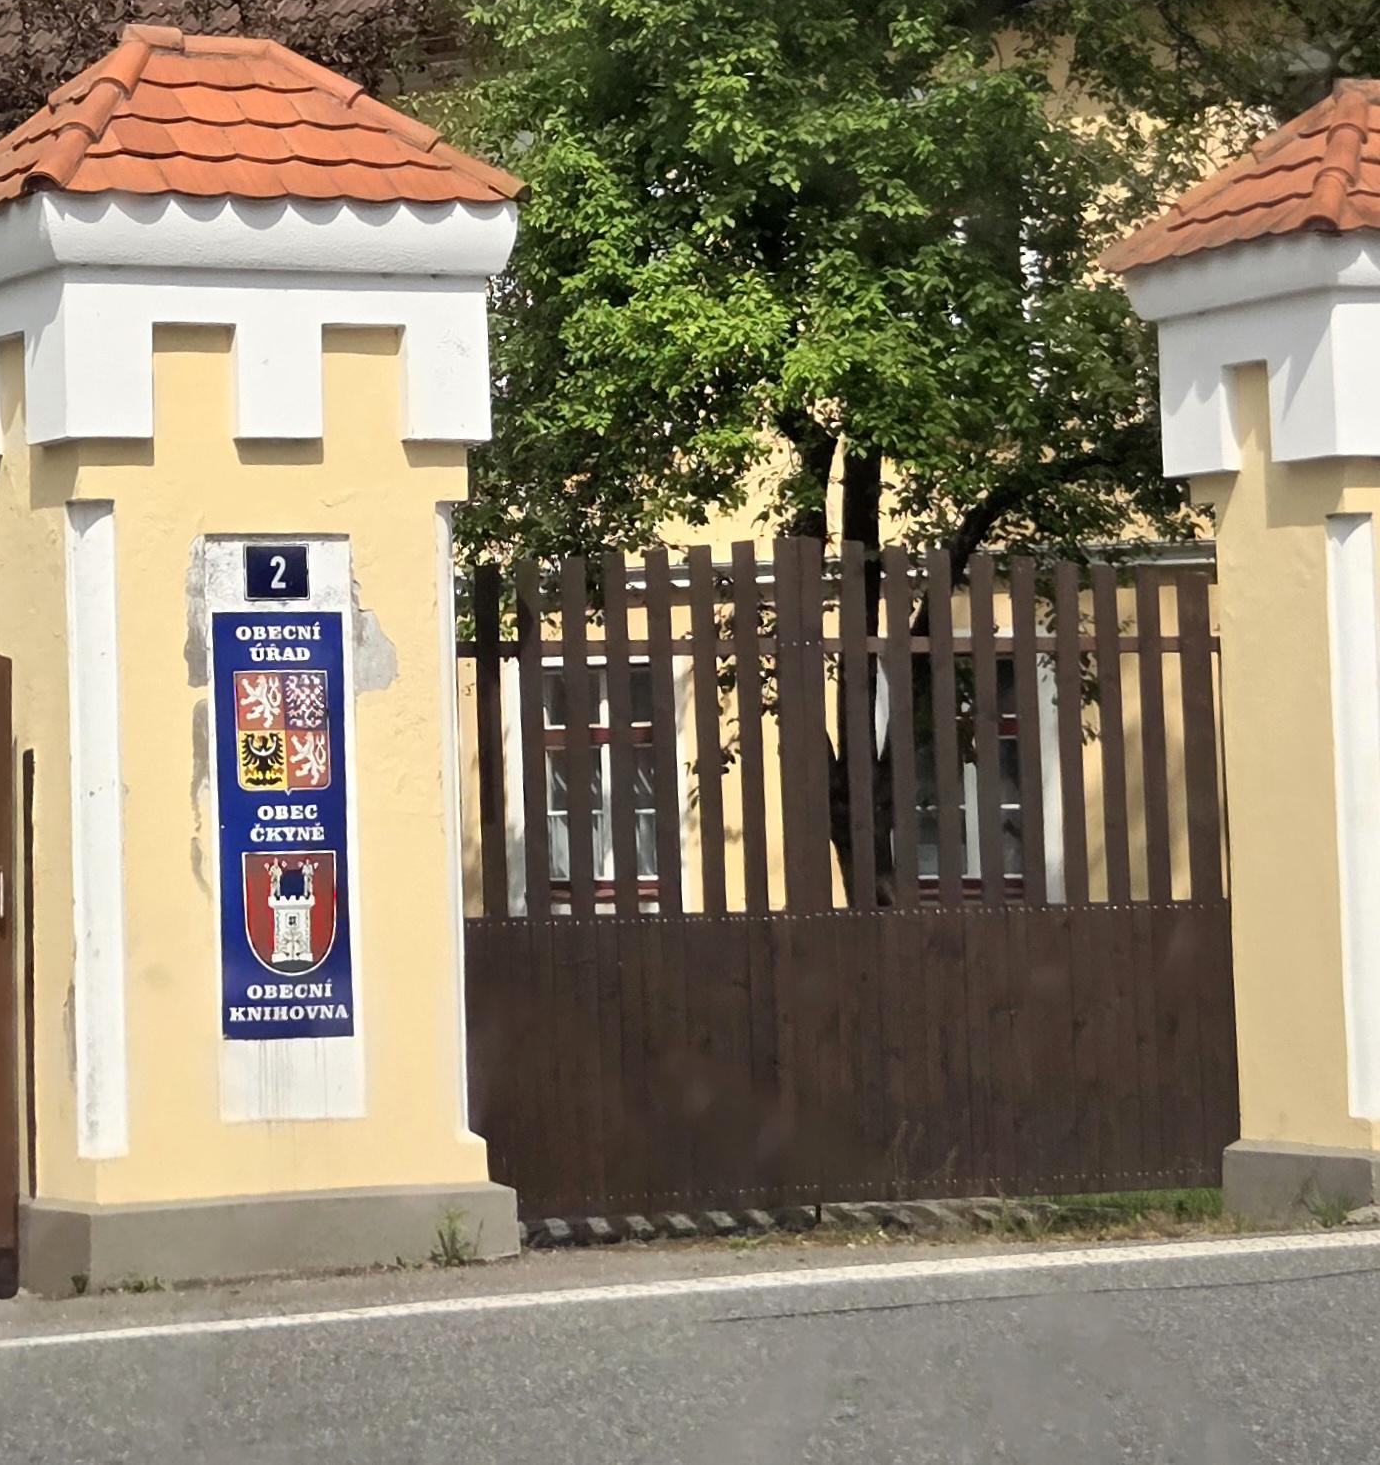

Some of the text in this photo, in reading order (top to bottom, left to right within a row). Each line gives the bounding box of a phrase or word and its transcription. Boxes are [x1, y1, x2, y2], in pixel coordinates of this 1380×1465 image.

[269, 555, 287, 589] 2
[235, 621, 322, 641] OBECNÍ
[248, 642, 311, 662] ÚŘAD
[257, 804, 318, 821] OBEC
[249, 822, 325, 844] ČKYNĚ
[246, 978, 333, 1000] OBECNÍ
[228, 1003, 350, 1023] KNIHOVNA
